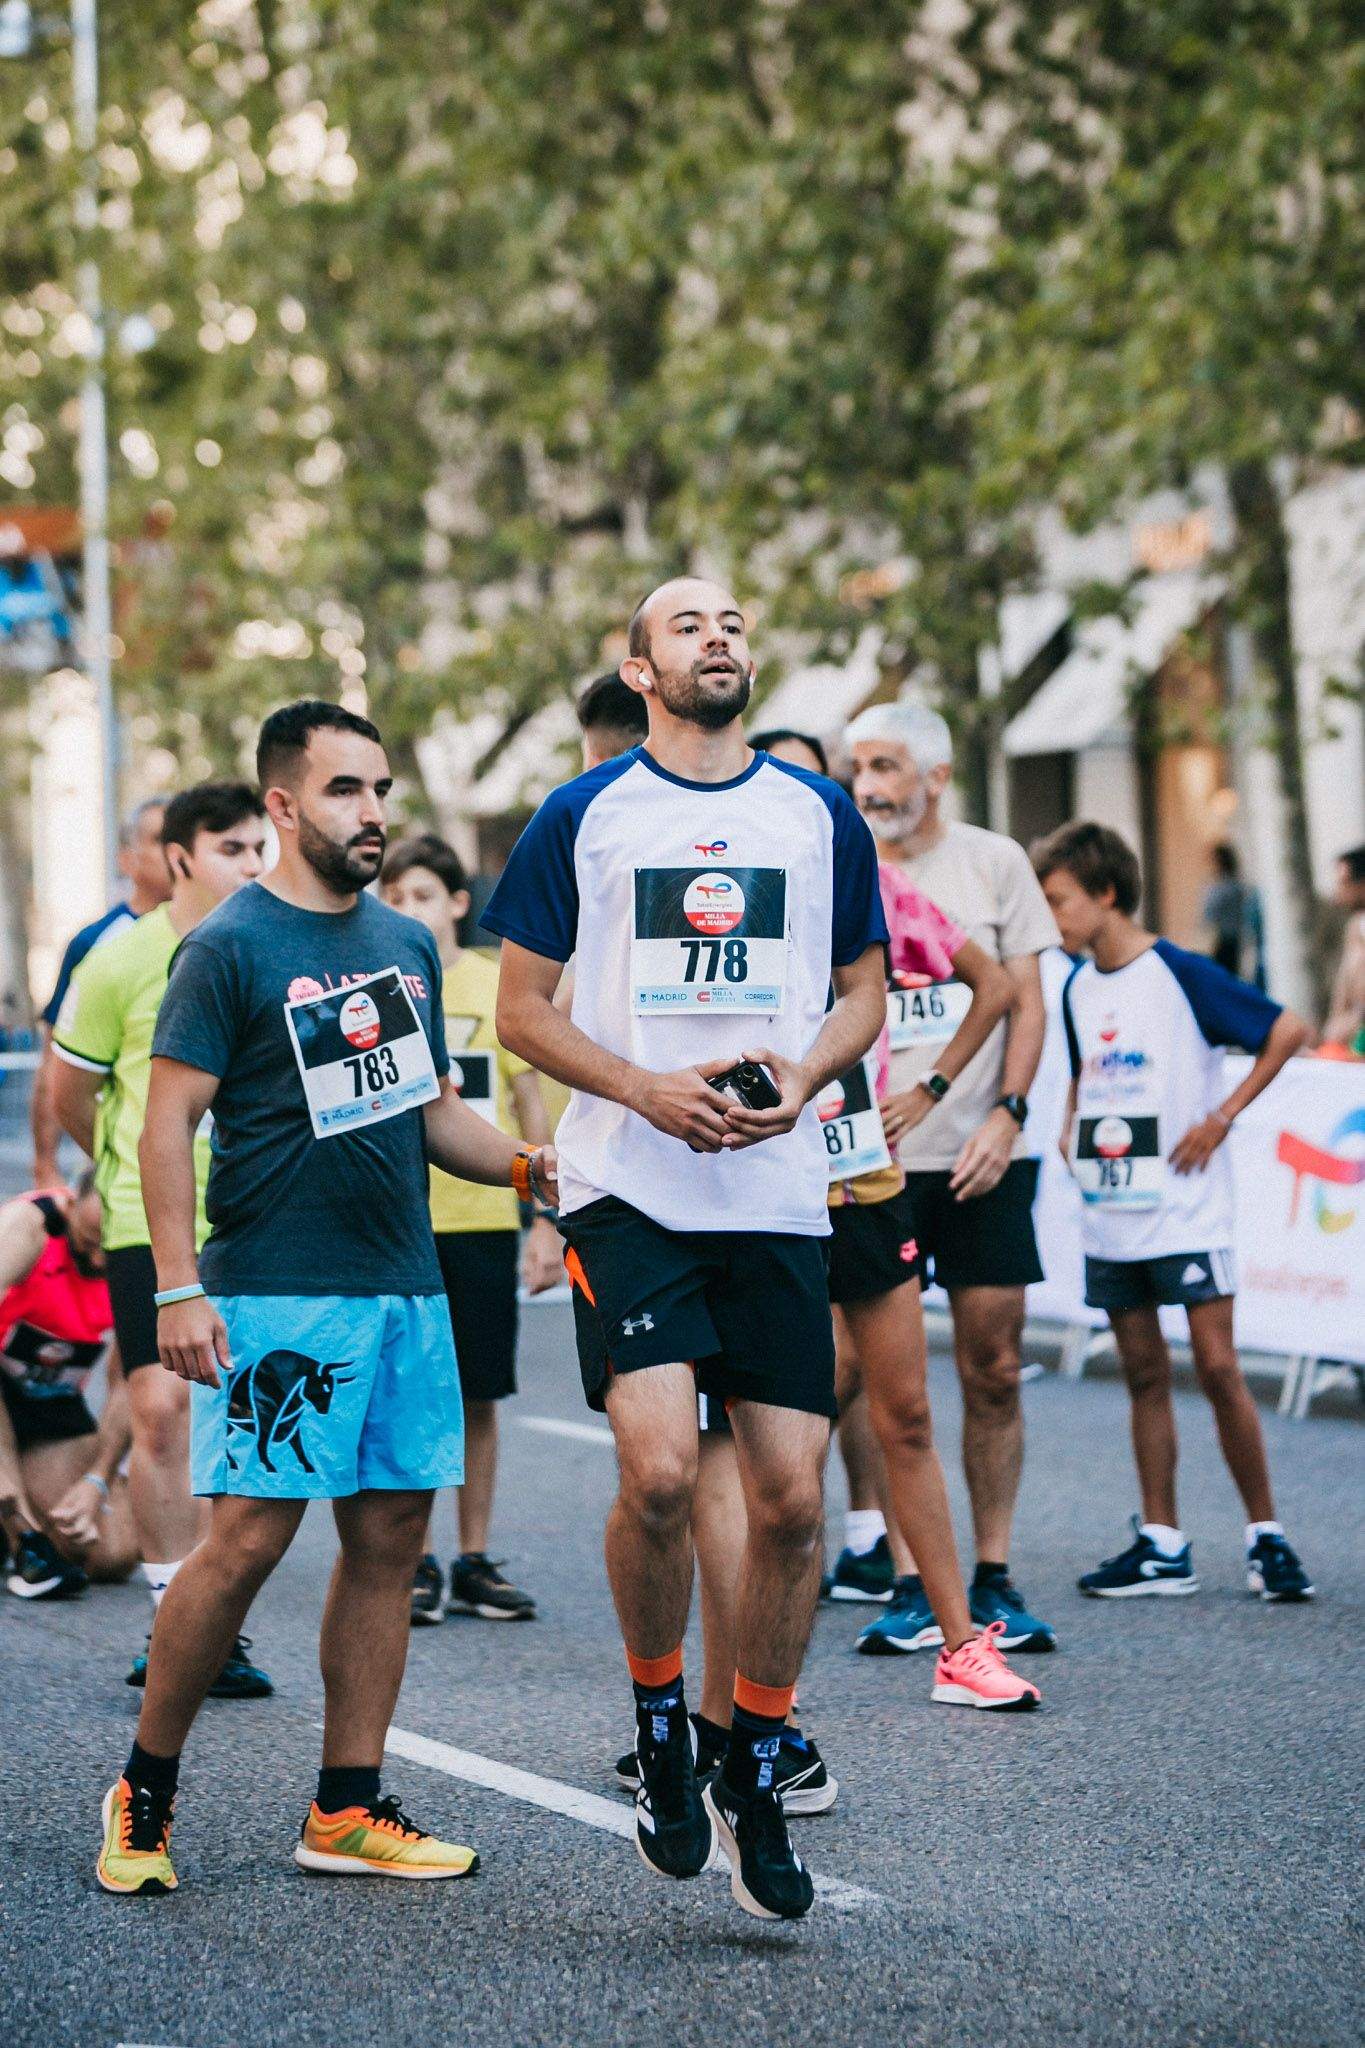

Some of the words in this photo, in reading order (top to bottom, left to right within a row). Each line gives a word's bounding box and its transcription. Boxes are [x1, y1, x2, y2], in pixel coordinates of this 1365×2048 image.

[680, 939, 748, 983] 778
[651, 992, 688, 1001] MADRID
[895, 990, 945, 1022] 746
[343, 1046, 400, 1099] 783
